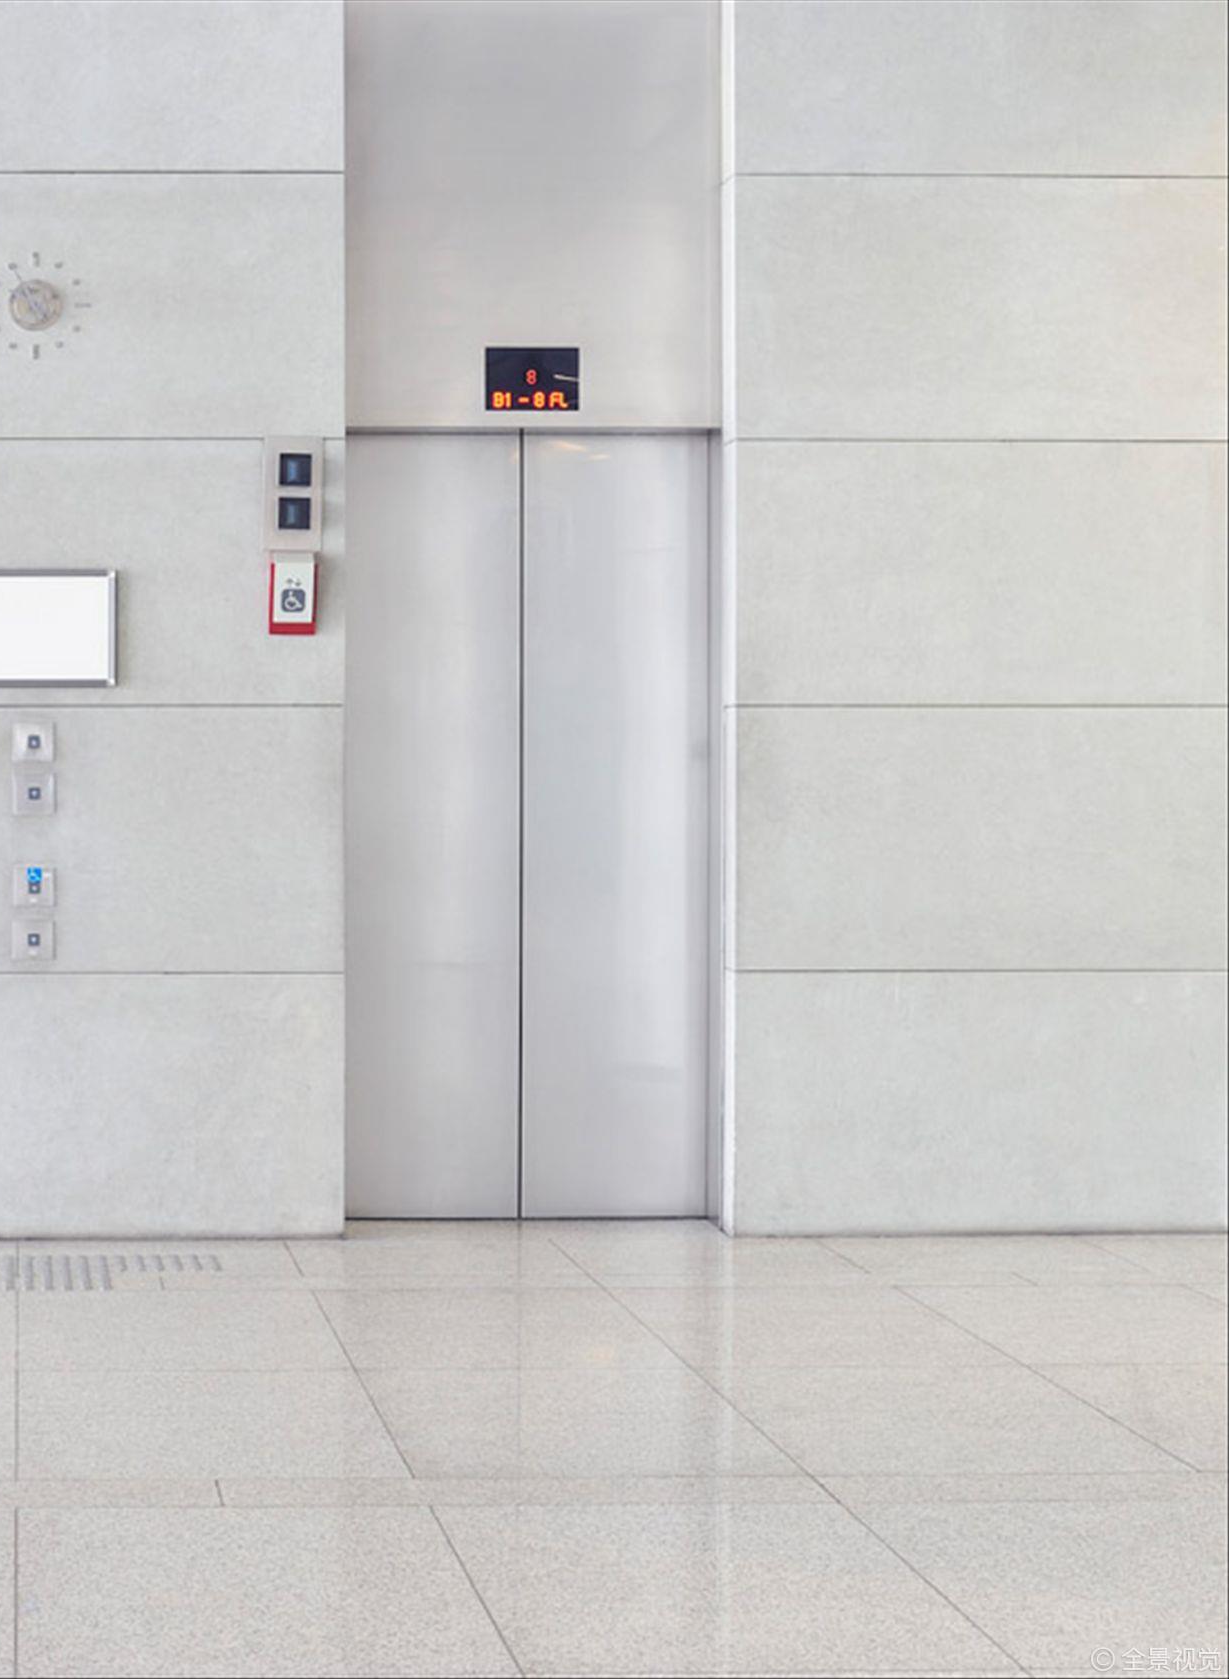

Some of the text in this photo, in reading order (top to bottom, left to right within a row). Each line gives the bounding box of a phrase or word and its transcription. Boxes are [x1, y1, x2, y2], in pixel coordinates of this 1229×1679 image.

[526, 369, 537, 385] 8
[492, 391, 512, 409] B1
[533, 391, 546, 409] 8
